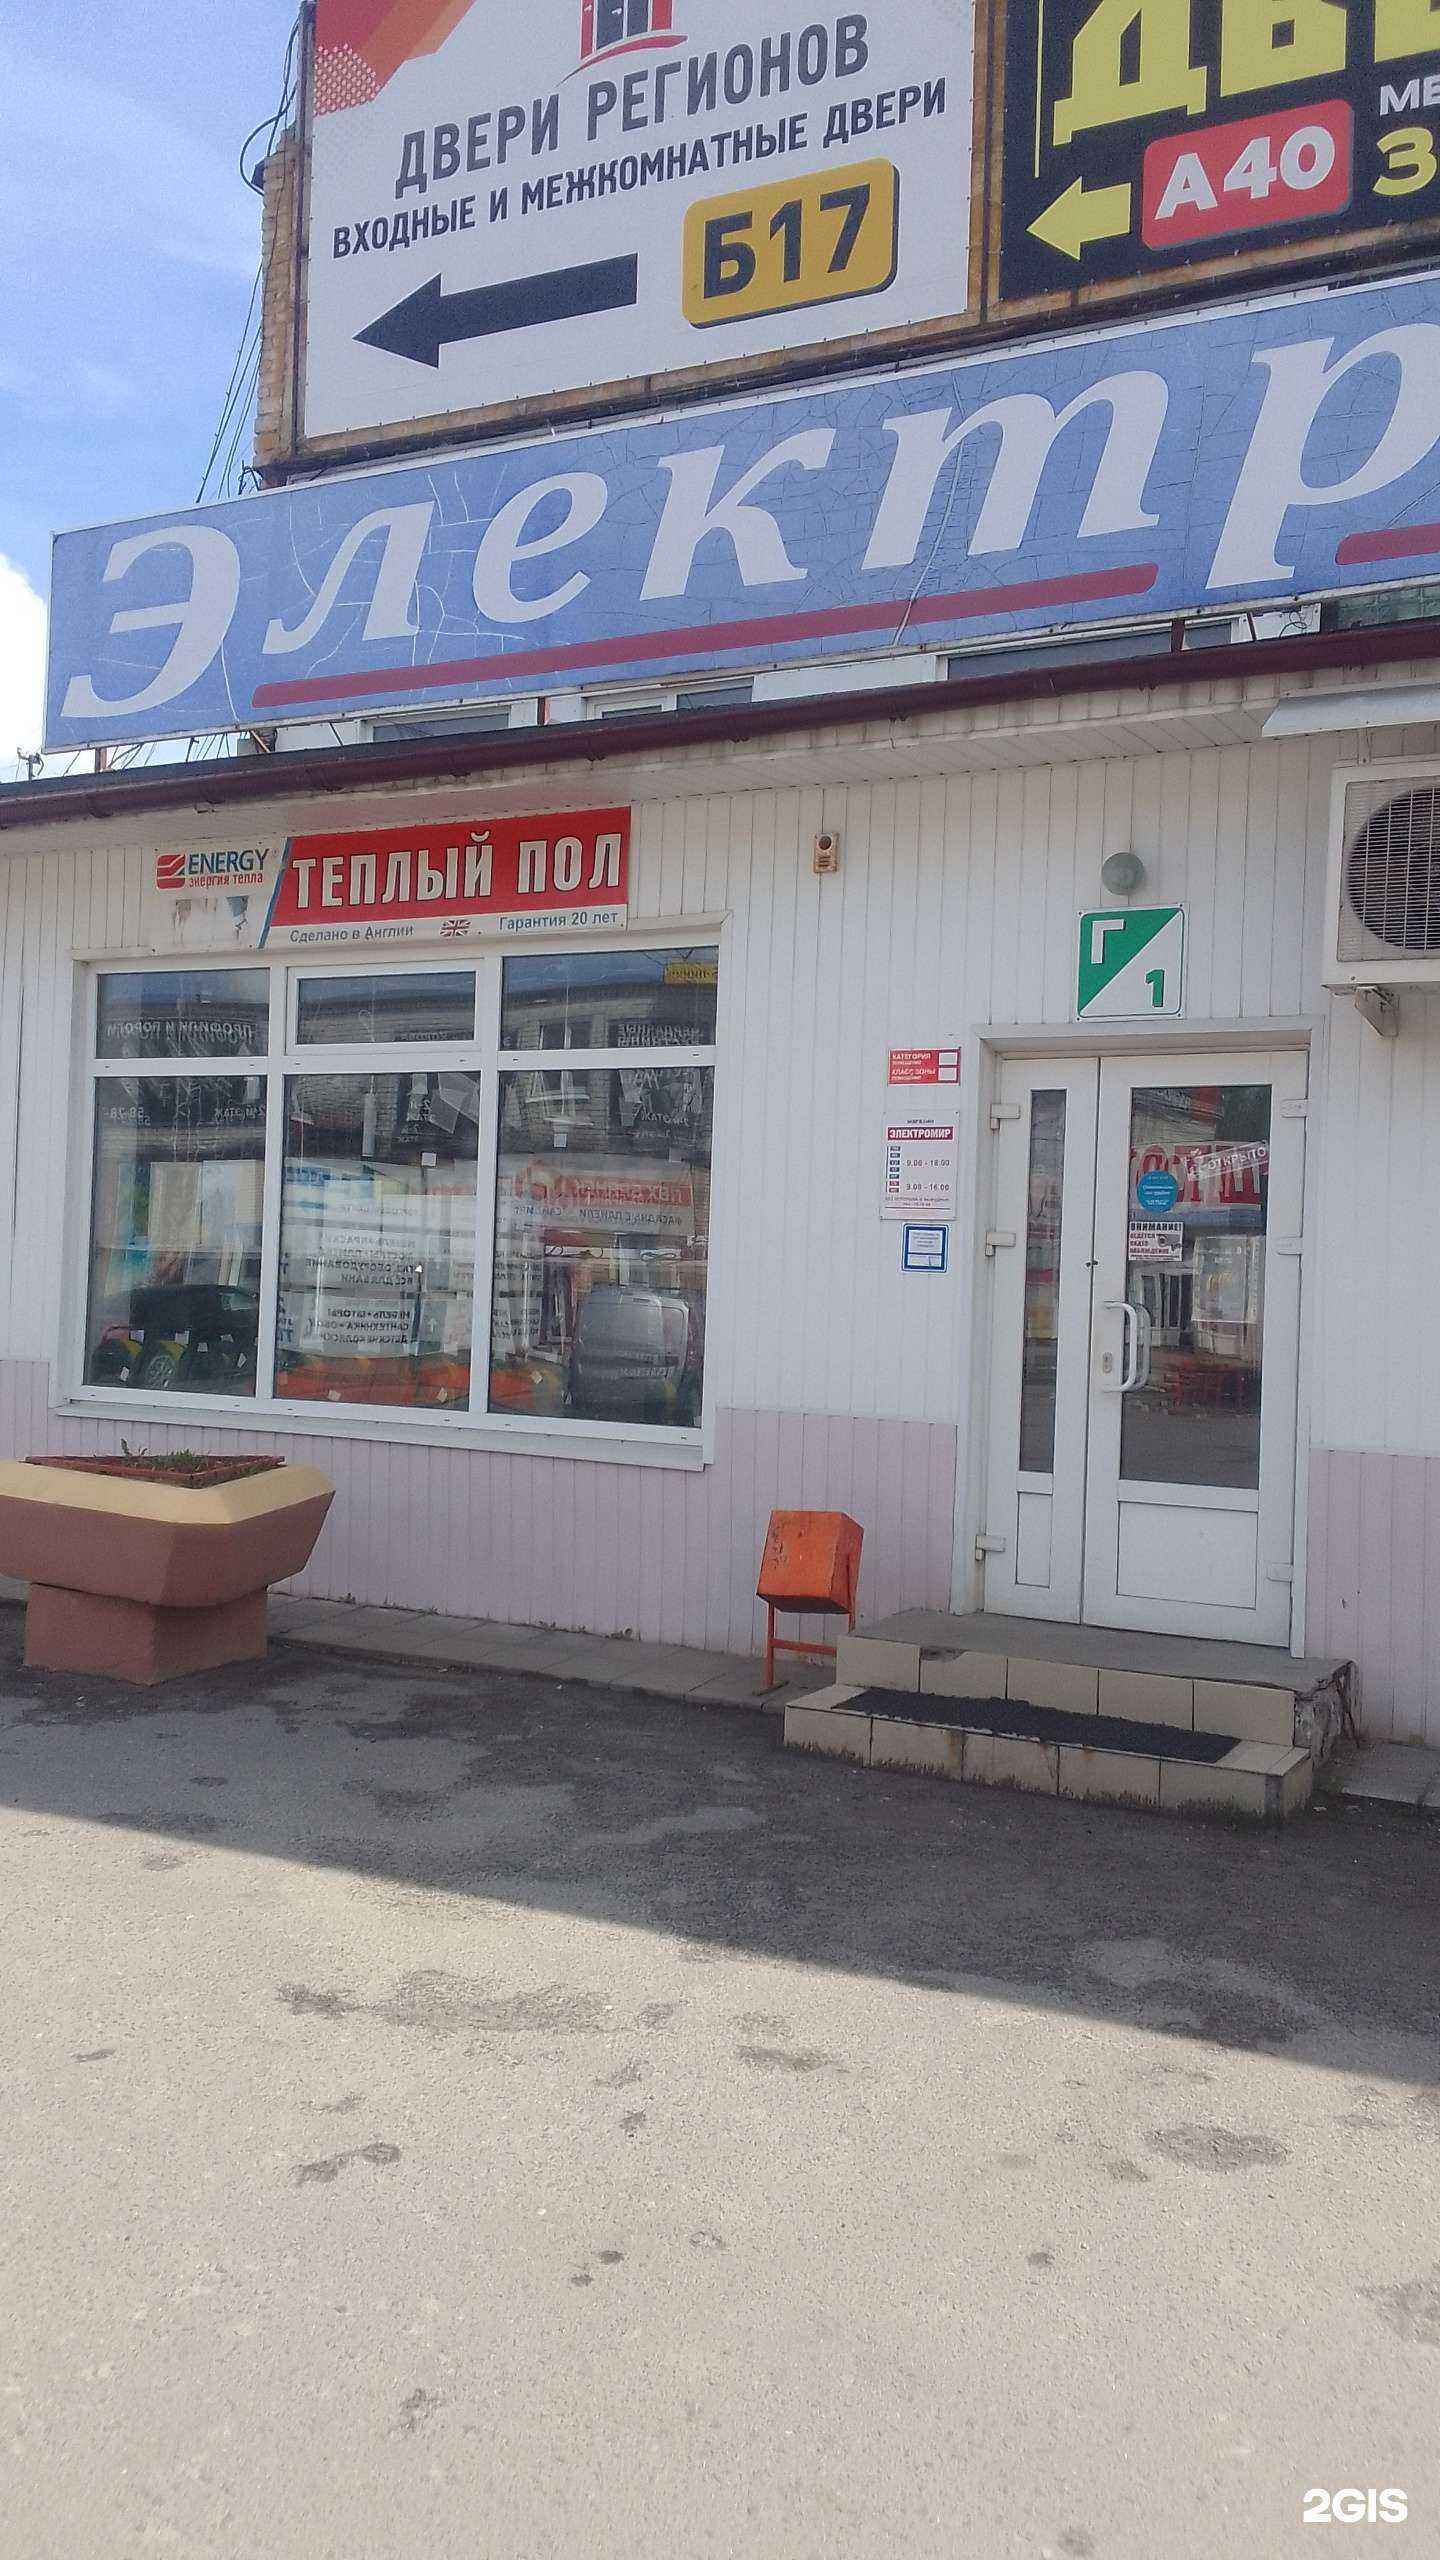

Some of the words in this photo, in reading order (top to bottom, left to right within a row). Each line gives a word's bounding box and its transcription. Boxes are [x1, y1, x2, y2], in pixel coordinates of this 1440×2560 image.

[1053, 0, 1440, 146] ДВ
[394, 92, 561, 200] ДВЕРИ
[587, 14, 869, 142] РЕГИОНОВ
[333, 195, 476, 259] ВХОДНЫЕ
[489, 185, 509, 223] И
[521, 112, 809, 217] МЕЖКОМНАТНЫЕ
[822, 77, 947, 149] ДВЕРИ
[1154, 125, 1336, 221] А40
[703, 183, 871, 299] Б17
[60, 322, 1440, 719] Электр
[188, 848, 269, 875] ENERGY
[189, 875, 230, 889] энергия
[233, 873, 263, 885] тепла
[292, 830, 492, 909] ТЕПЛЫЙ
[517, 833, 622, 894] ПОЛ
[290, 929, 348, 944] Сделано
[352, 929, 361, 940] в
[366, 925, 413, 940] Англии
[500, 916, 566, 932] Гарантия
[572, 911, 588, 925] 20
[592, 912, 618, 924] лет
[1091, 918, 1125, 964] Г
[1145, 968, 1166, 1008] 1
[892, 1052, 931, 1060] КАТЕГОРИЯ
[889, 1129, 951, 1139] ЭЛЕКТРОМИР
[1207, 1146, 1266, 1170] ОТКРЫТО
[1130, 1222, 1181, 1231] ВНИМАНИЕ!
